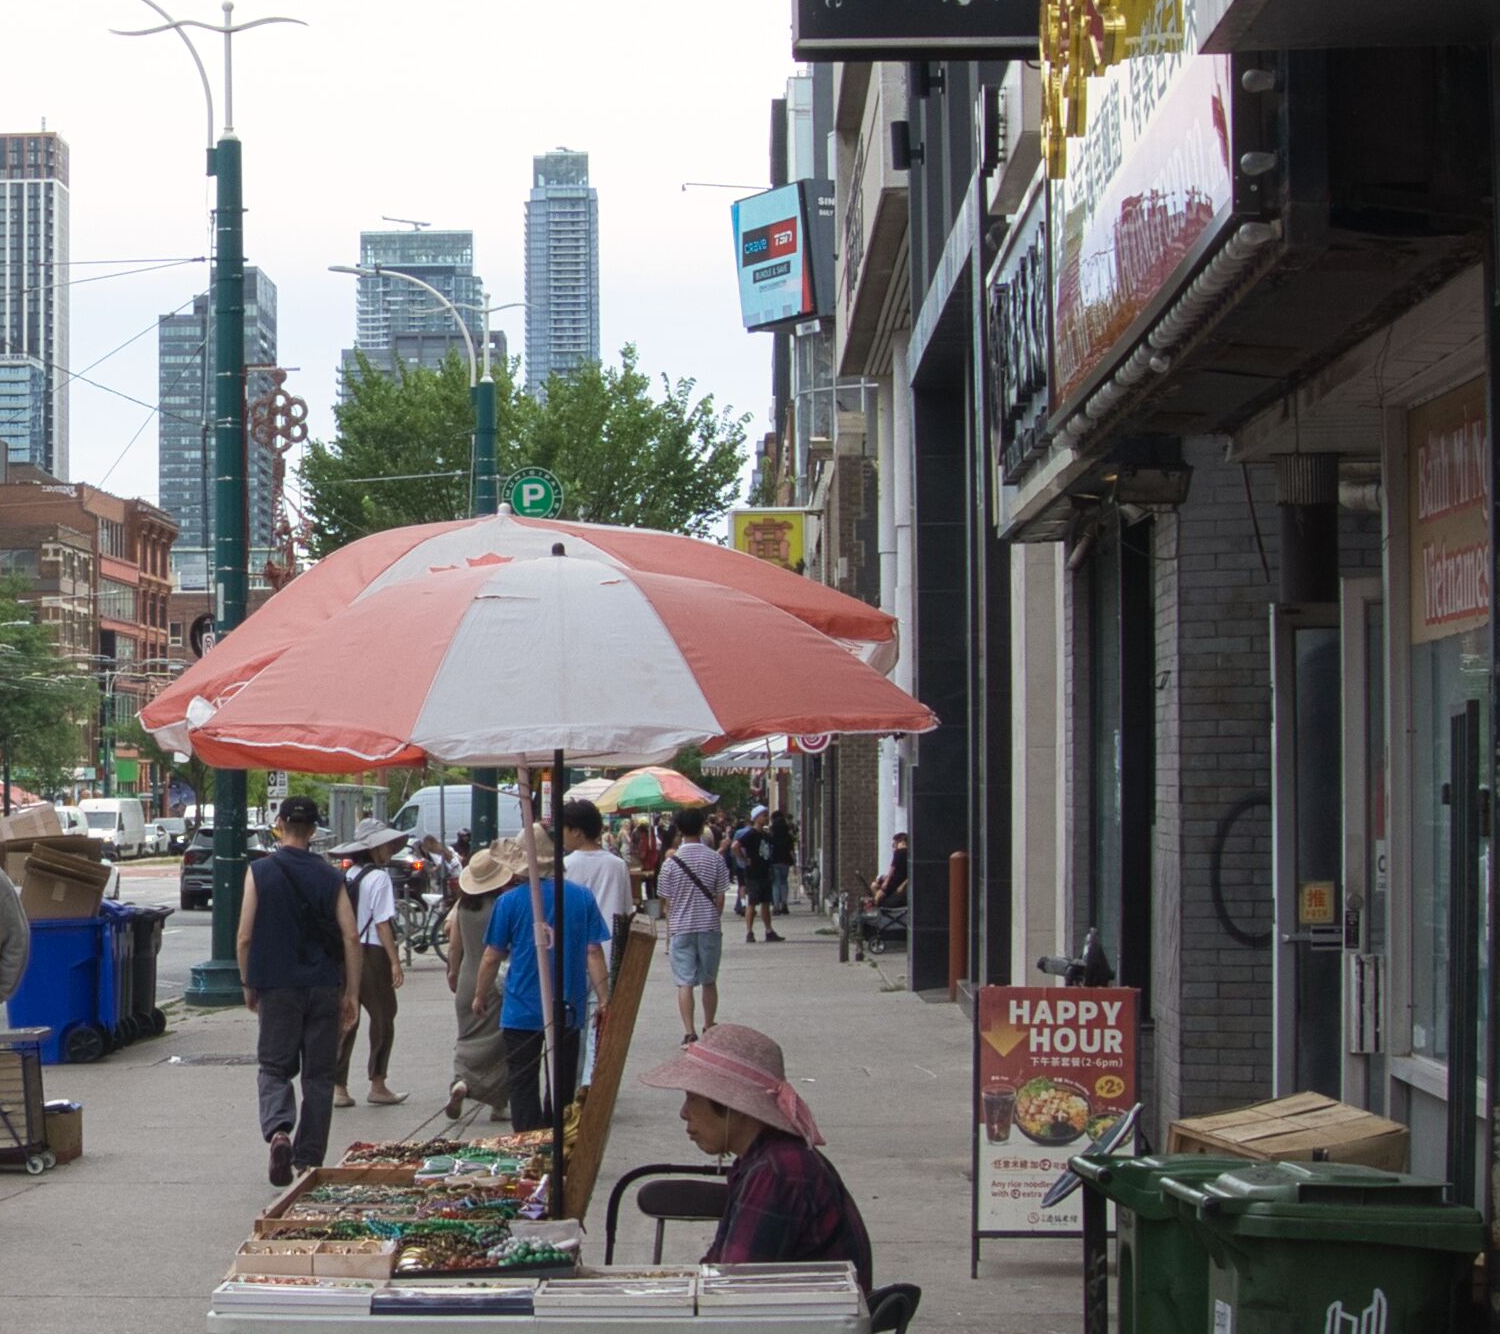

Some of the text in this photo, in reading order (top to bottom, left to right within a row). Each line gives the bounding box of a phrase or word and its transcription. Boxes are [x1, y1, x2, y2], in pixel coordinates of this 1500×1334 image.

[523, 483, 545, 507] P
[1009, 999, 1123, 1025] HAPPY
[1029, 1027, 1123, 1053] HOUR
[991, 1180, 1006, 1189] Any
[1008, 1180, 1022, 1188] rice
[991, 1190, 1009, 1198] with
